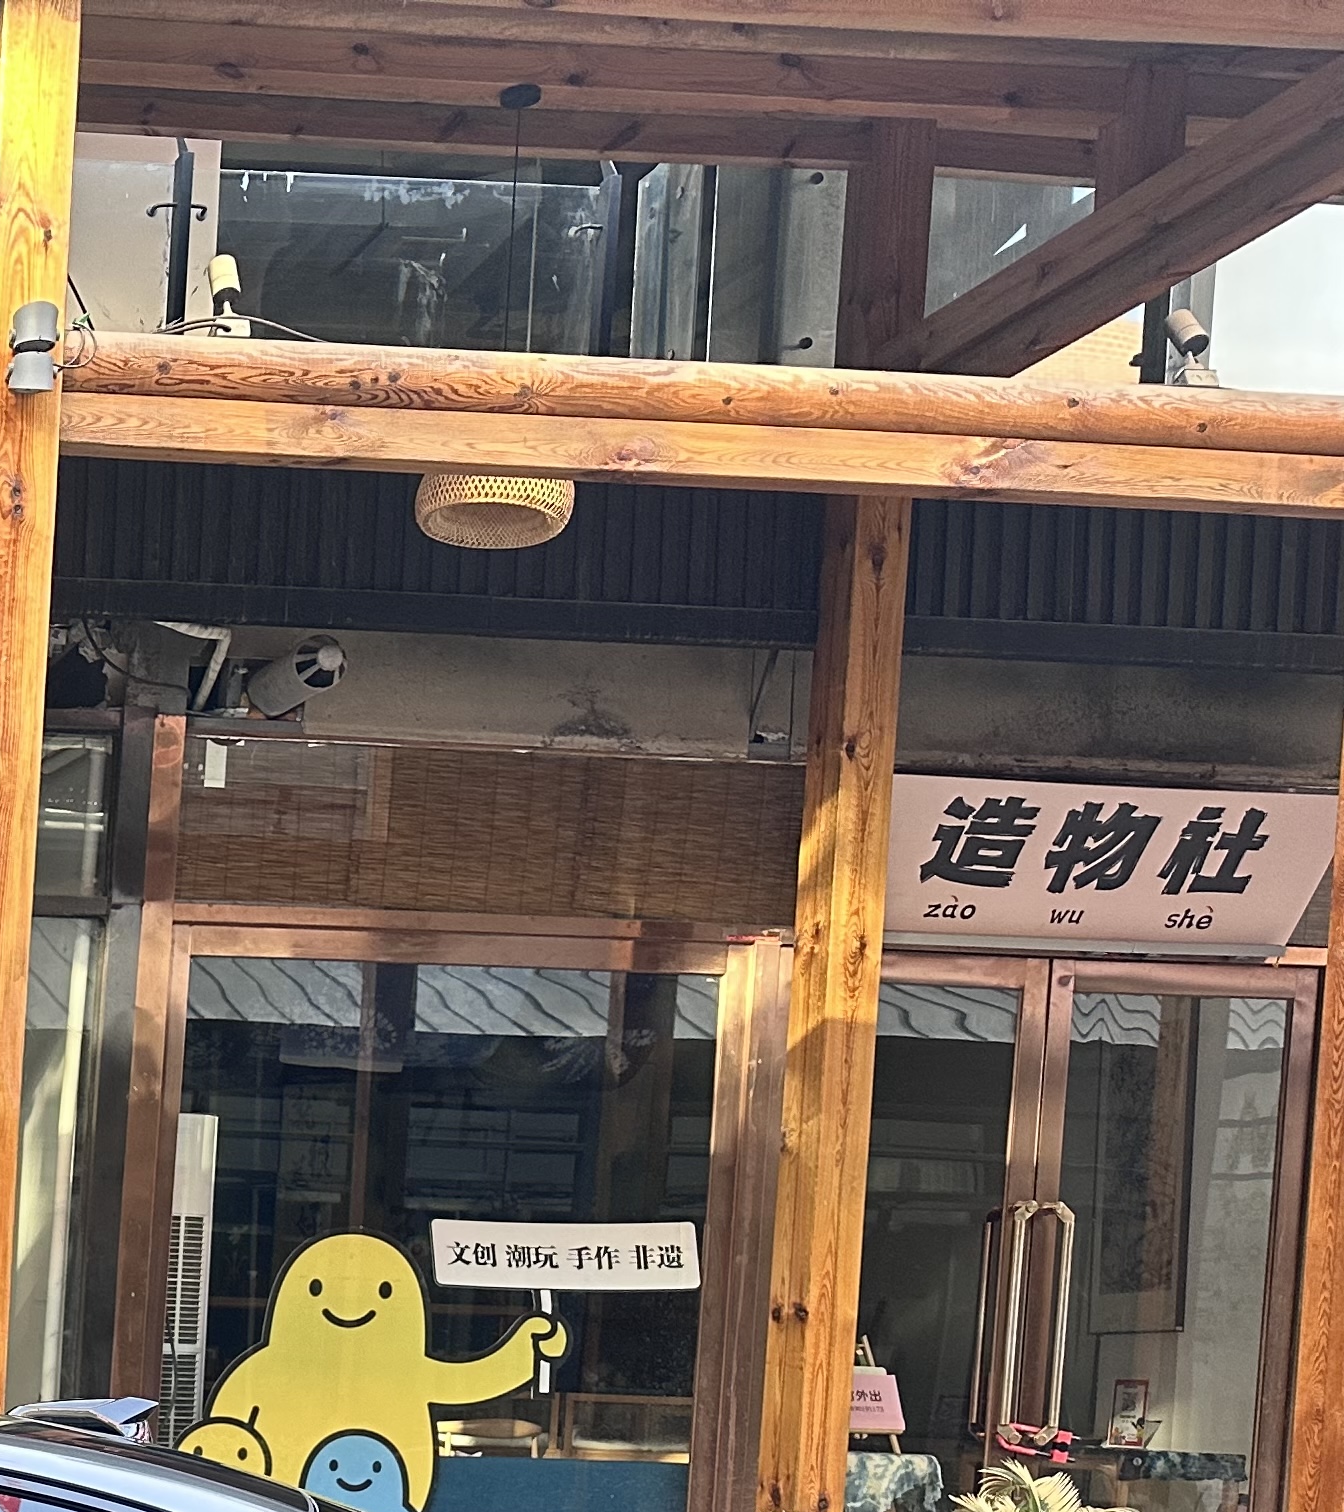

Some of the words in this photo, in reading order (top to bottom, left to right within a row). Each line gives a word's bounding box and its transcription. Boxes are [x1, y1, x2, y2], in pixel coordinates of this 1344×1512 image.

[919, 796, 1270, 896] 造物社
[923, 894, 977, 920] zào
[1050, 909, 1085, 925] wu
[1164, 905, 1214, 930] shè
[446, 1241, 497, 1267] 文创
[505, 1244, 559, 1270] 潮玩
[566, 1245, 620, 1271] 手作
[628, 1245, 685, 1270] 非遗
[851, 1389, 882, 1402] 外出
